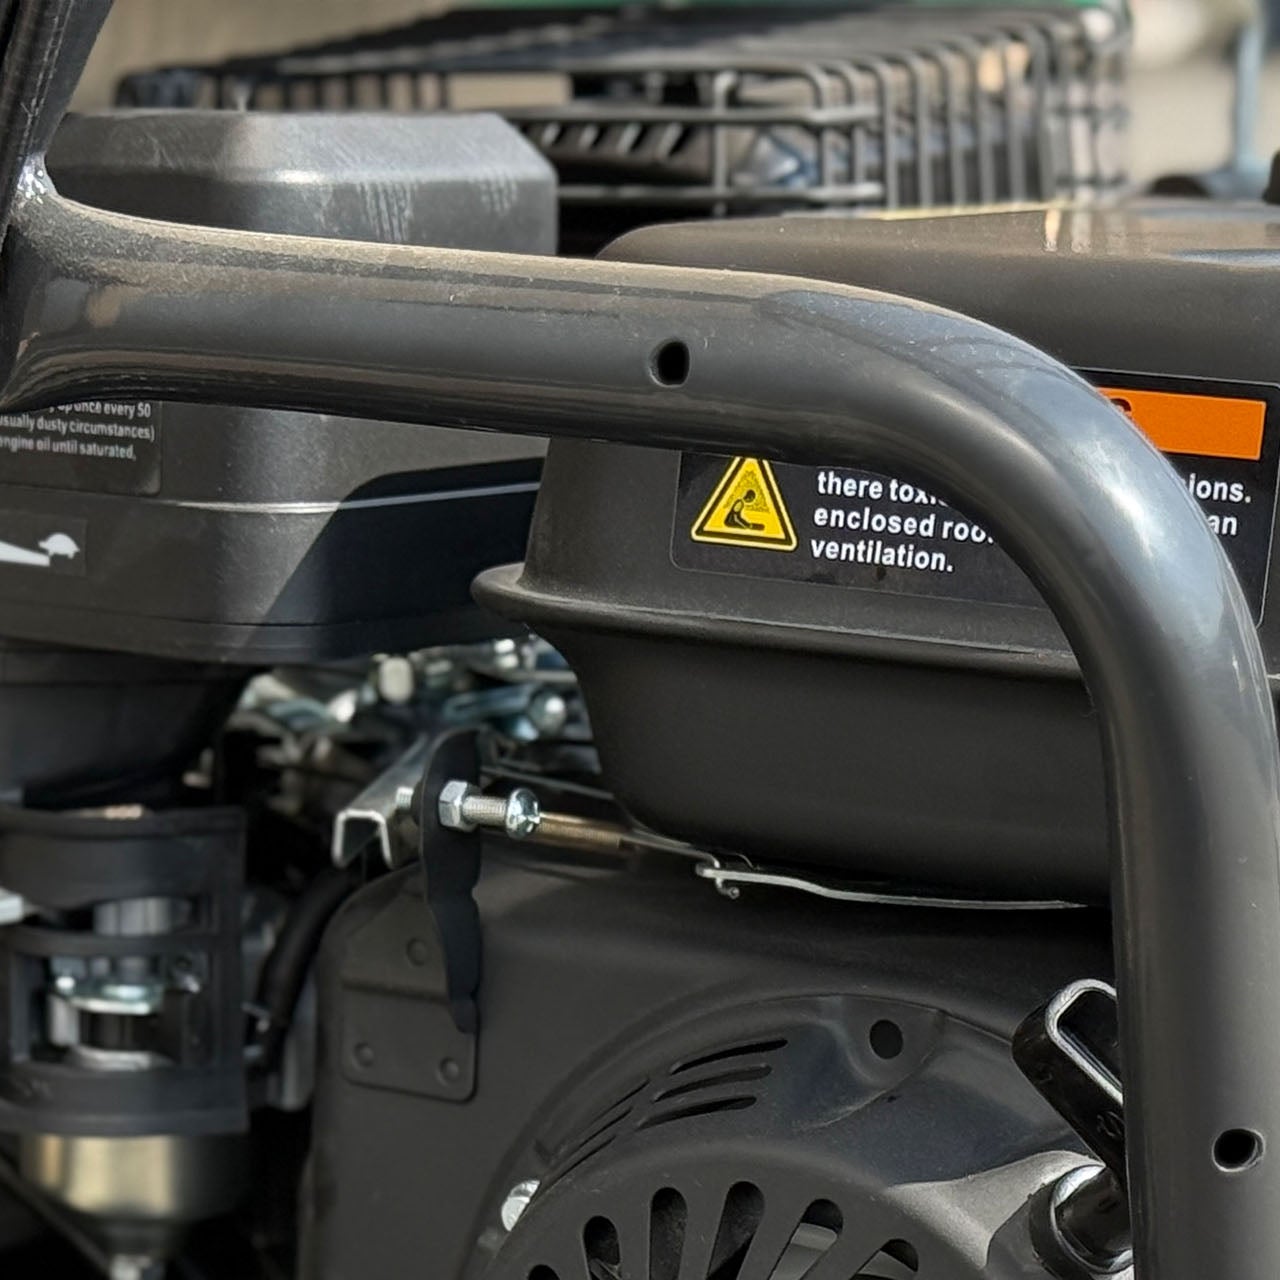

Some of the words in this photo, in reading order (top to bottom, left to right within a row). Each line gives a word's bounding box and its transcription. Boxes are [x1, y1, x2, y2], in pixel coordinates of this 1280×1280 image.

[104, 402, 135, 420] every
[137, 402, 151, 418] 50
[37, 416, 68, 435] dusty
[69, 420, 155, 442] circumstances)
[37, 436, 50, 451] oil
[53, 439, 77, 454] until
[817, 471, 883, 499] there
[813, 507, 936, 538] enclosed
[941, 520, 994, 544] roo
[811, 539, 954, 573] ventilation.
